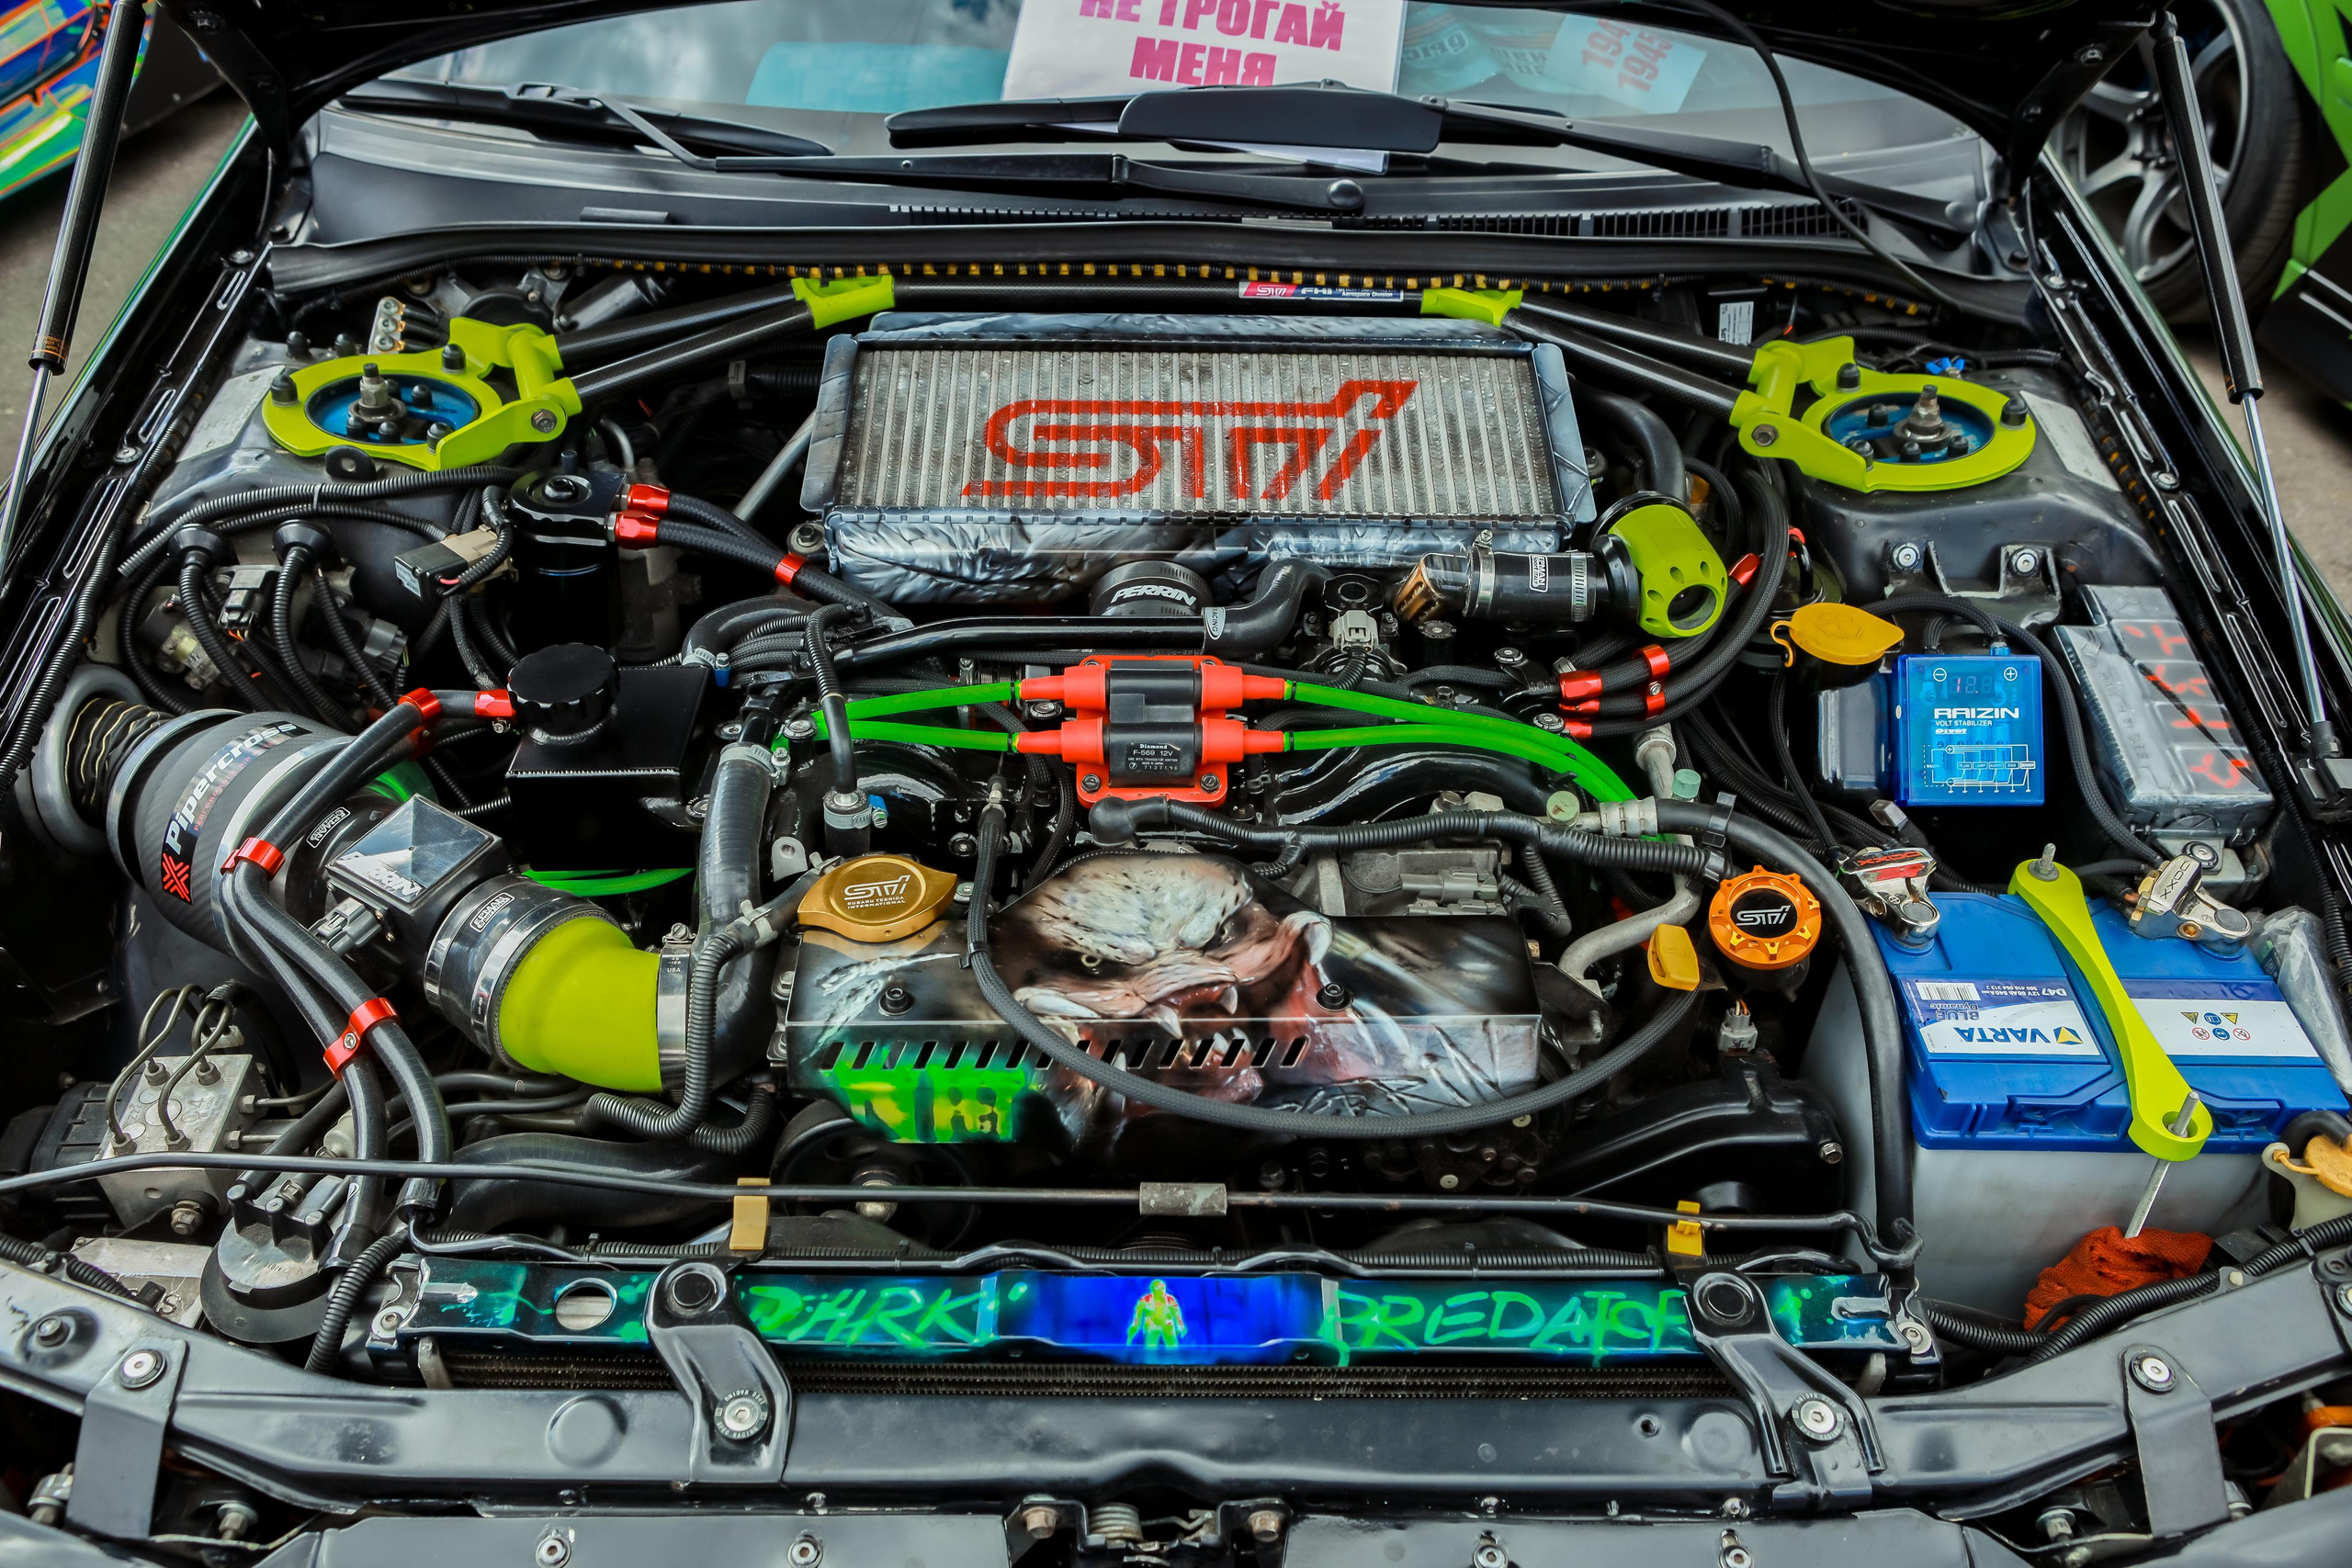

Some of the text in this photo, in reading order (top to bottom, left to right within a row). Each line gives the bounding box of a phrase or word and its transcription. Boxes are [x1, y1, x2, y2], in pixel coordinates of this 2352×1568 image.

[1159, 0, 1345, 51] ТРОГАЙ
[1582, 18, 1631, 69] 194
[1129, 37, 1277, 86] МЕНЯ
[1110, 584, 1196, 606] PERRIN
[1933, 707, 2019, 719] RAIZIN
[165, 723, 297, 855] Pipercross
[473, 897, 505, 924] EPMAN
[847, 900, 906, 909] INTERNATIONAL
[2041, 987, 2068, 997] D47
[1930, 1002, 1979, 1010] Dynamic
[1936, 1010, 1979, 1021] BLUE
[1953, 1027, 2052, 1043] VARTA
[732, 1427, 759, 1438] RACING
